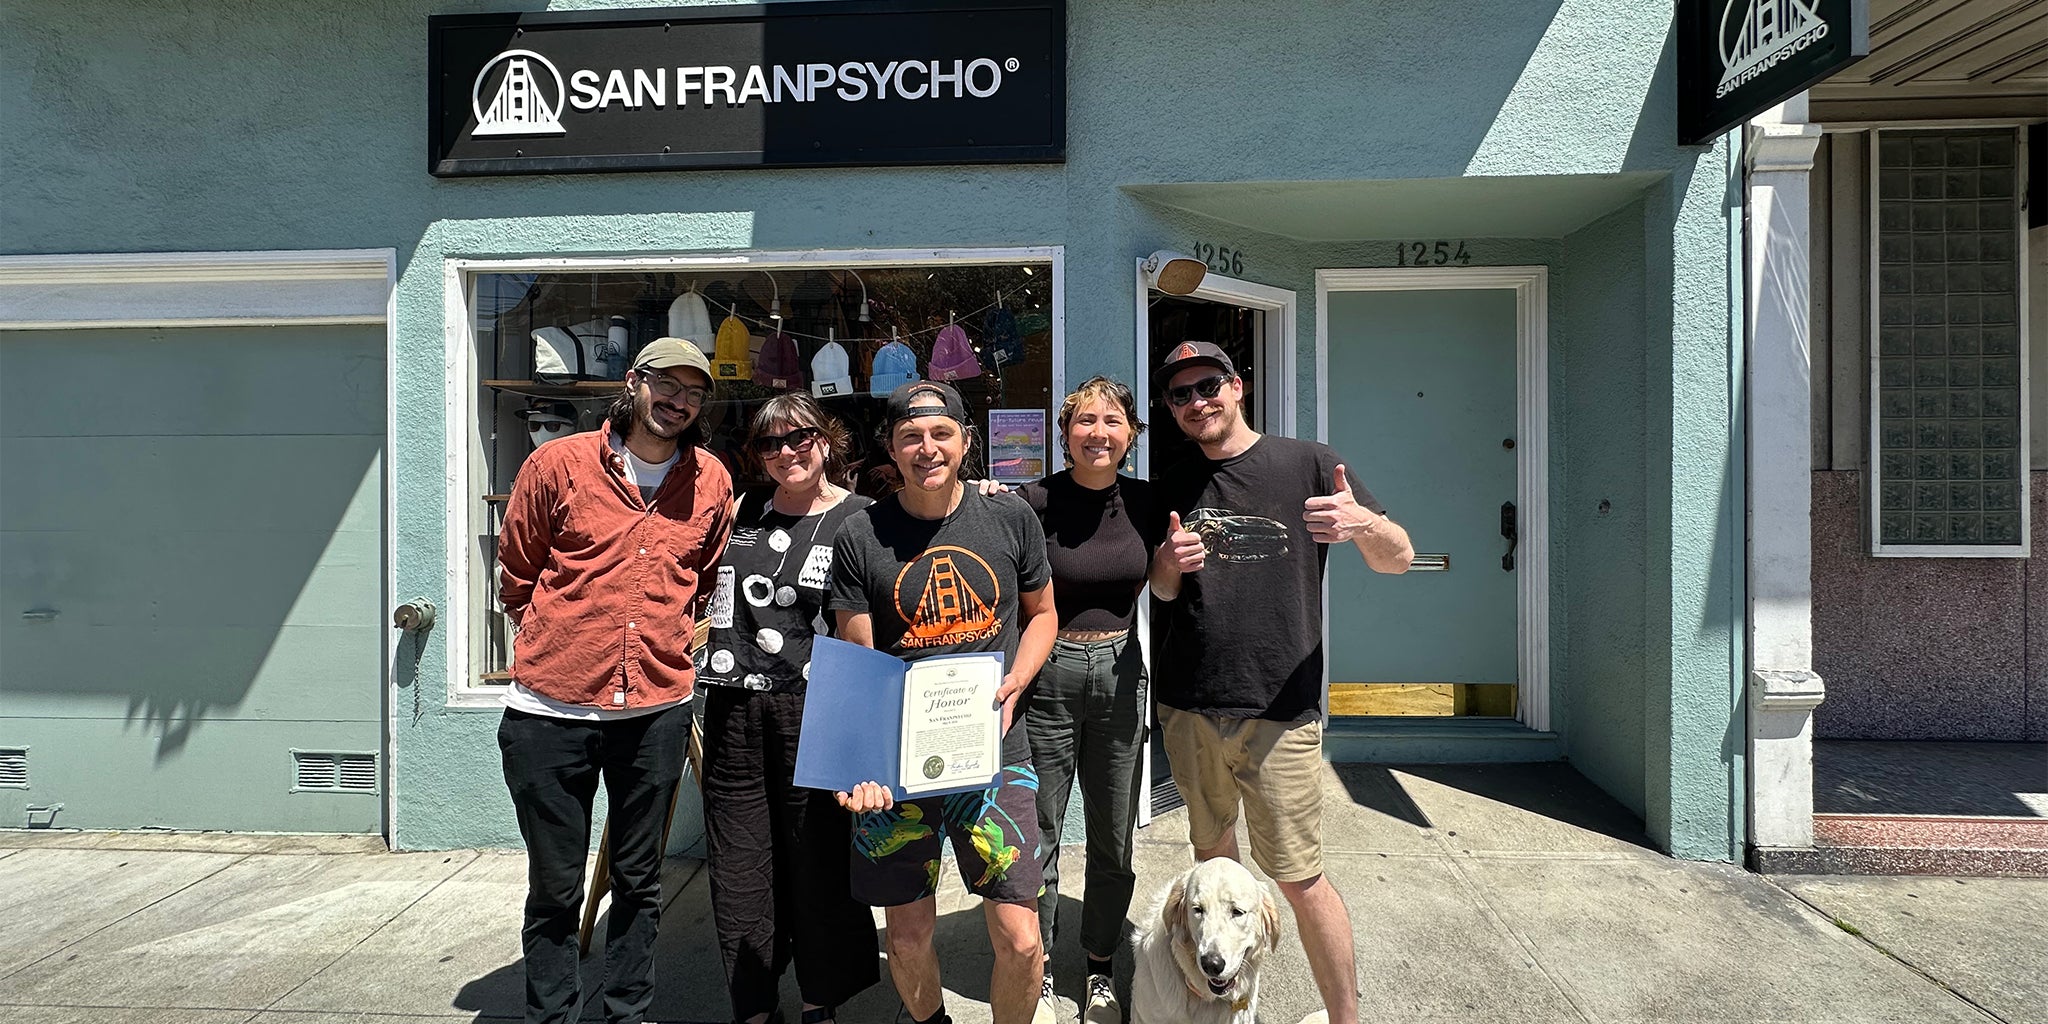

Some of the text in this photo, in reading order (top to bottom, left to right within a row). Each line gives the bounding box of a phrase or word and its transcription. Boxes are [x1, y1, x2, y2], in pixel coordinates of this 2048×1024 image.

[1716, 23, 1829, 99] SAN FRANPSYCHO
[569, 67, 666, 110] SAN
[1194, 241, 1243, 276] 1256
[1396, 241, 1471, 266] 1254
[900, 623, 1003, 648] SAN FRANPSYCHO
[923, 684, 979, 698] Certificate of
[925, 698, 971, 713] Honor
